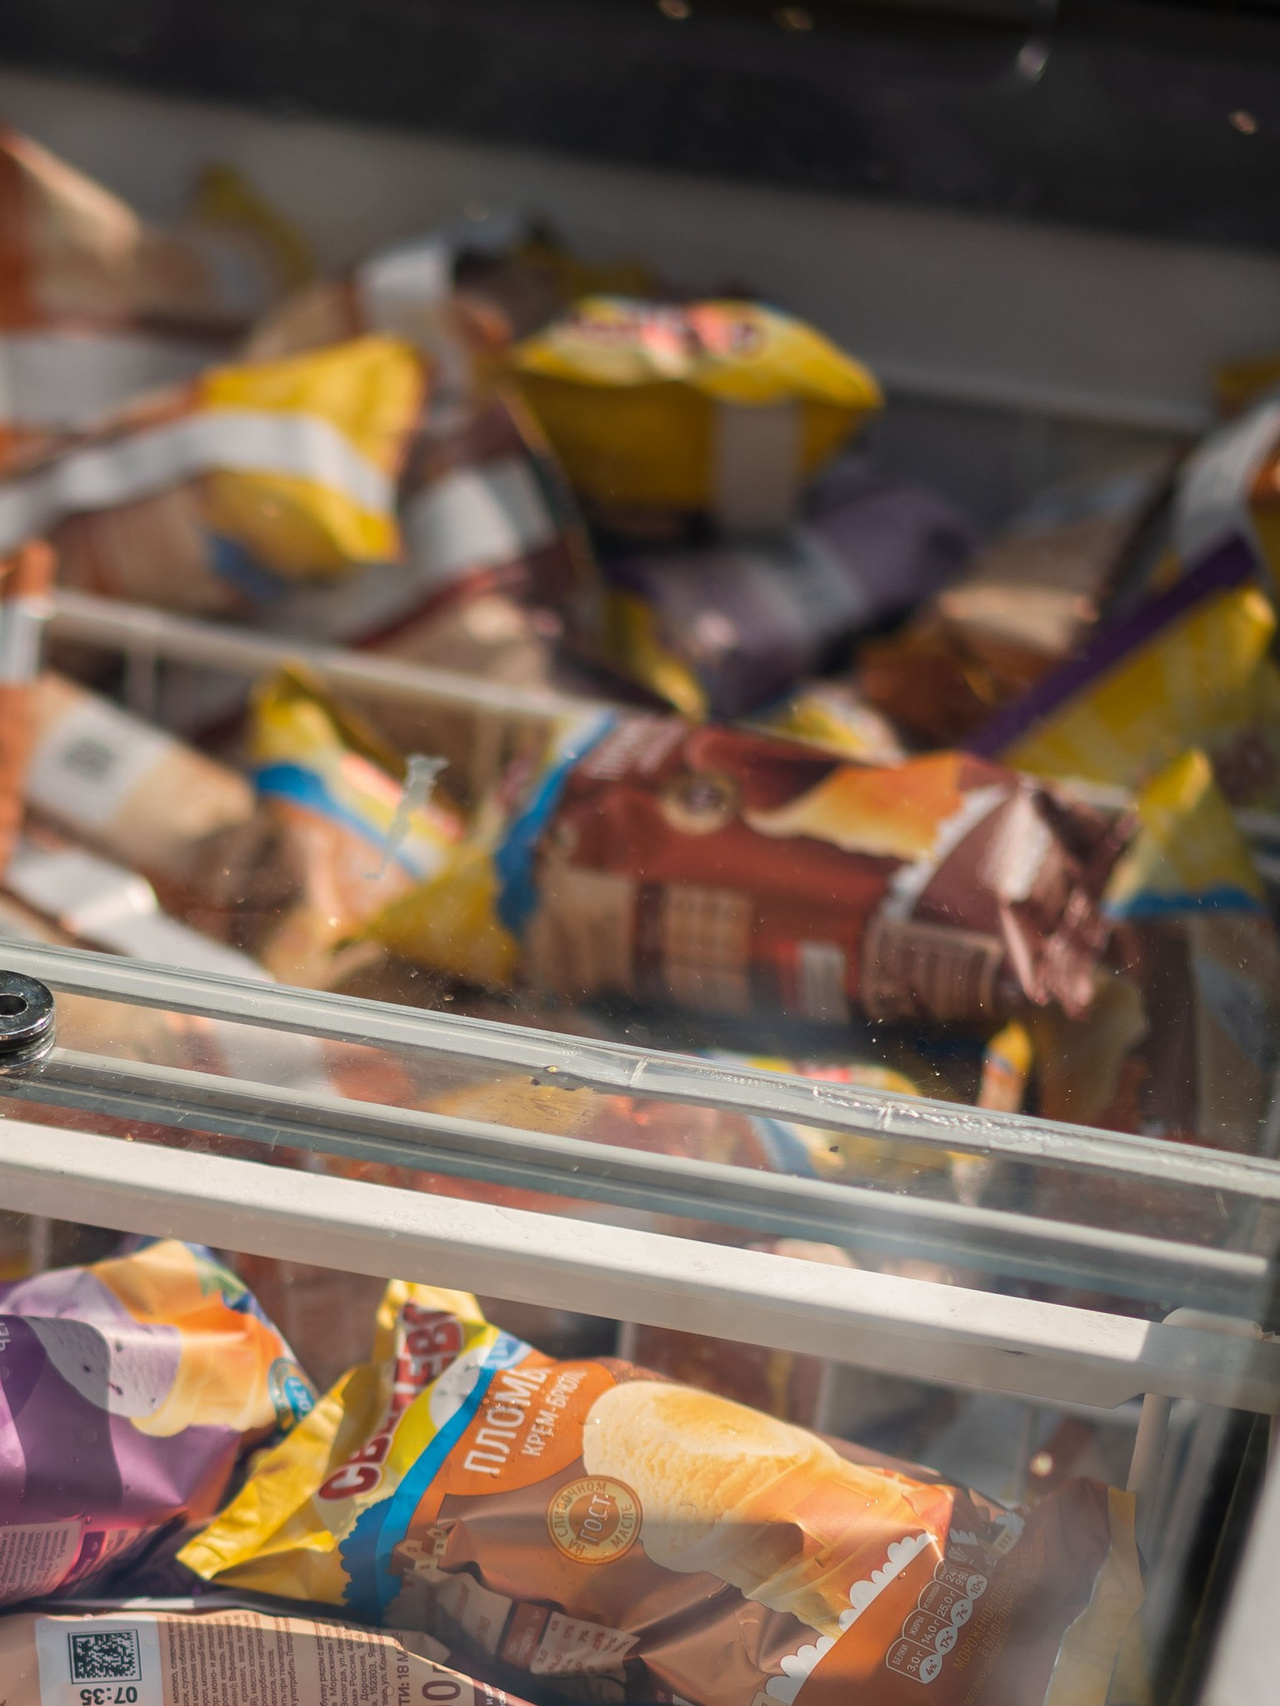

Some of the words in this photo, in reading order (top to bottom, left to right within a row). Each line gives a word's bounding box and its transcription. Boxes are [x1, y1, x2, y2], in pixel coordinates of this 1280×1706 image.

[580, 1495, 610, 1541] ГОСТ
[935, 1596, 954, 1617] 25,0
[908, 1615, 926, 1636] ЖИРЫ
[920, 1624, 938, 1644] 14,0
[951, 1603, 998, 1671] МОРОЖЕНОЕ
[267, 1648, 276, 1676] орехов.
[892, 1643, 909, 1665] БЕЛКИ
[905, 1655, 922, 1672] 3,0
[179, 1666, 188, 1688] сухое
[318, 1656, 327, 1681] рядом
[368, 1661, 378, 1694] 152303,
[398, 1666, 409, 1679] 18
[170, 1670, 179, 1702] молоко,
[189, 1663, 199, 1700] молочная
[210, 1669, 219, 1692] моно-
[238, 1665, 248, 1702] крахмал,
[248, 1668, 258, 1693] масло
[278, 1677, 287, 1692] при
[79, 1685, 137, 1705] 07:35
[319, 1683, 328, 1706] букву
